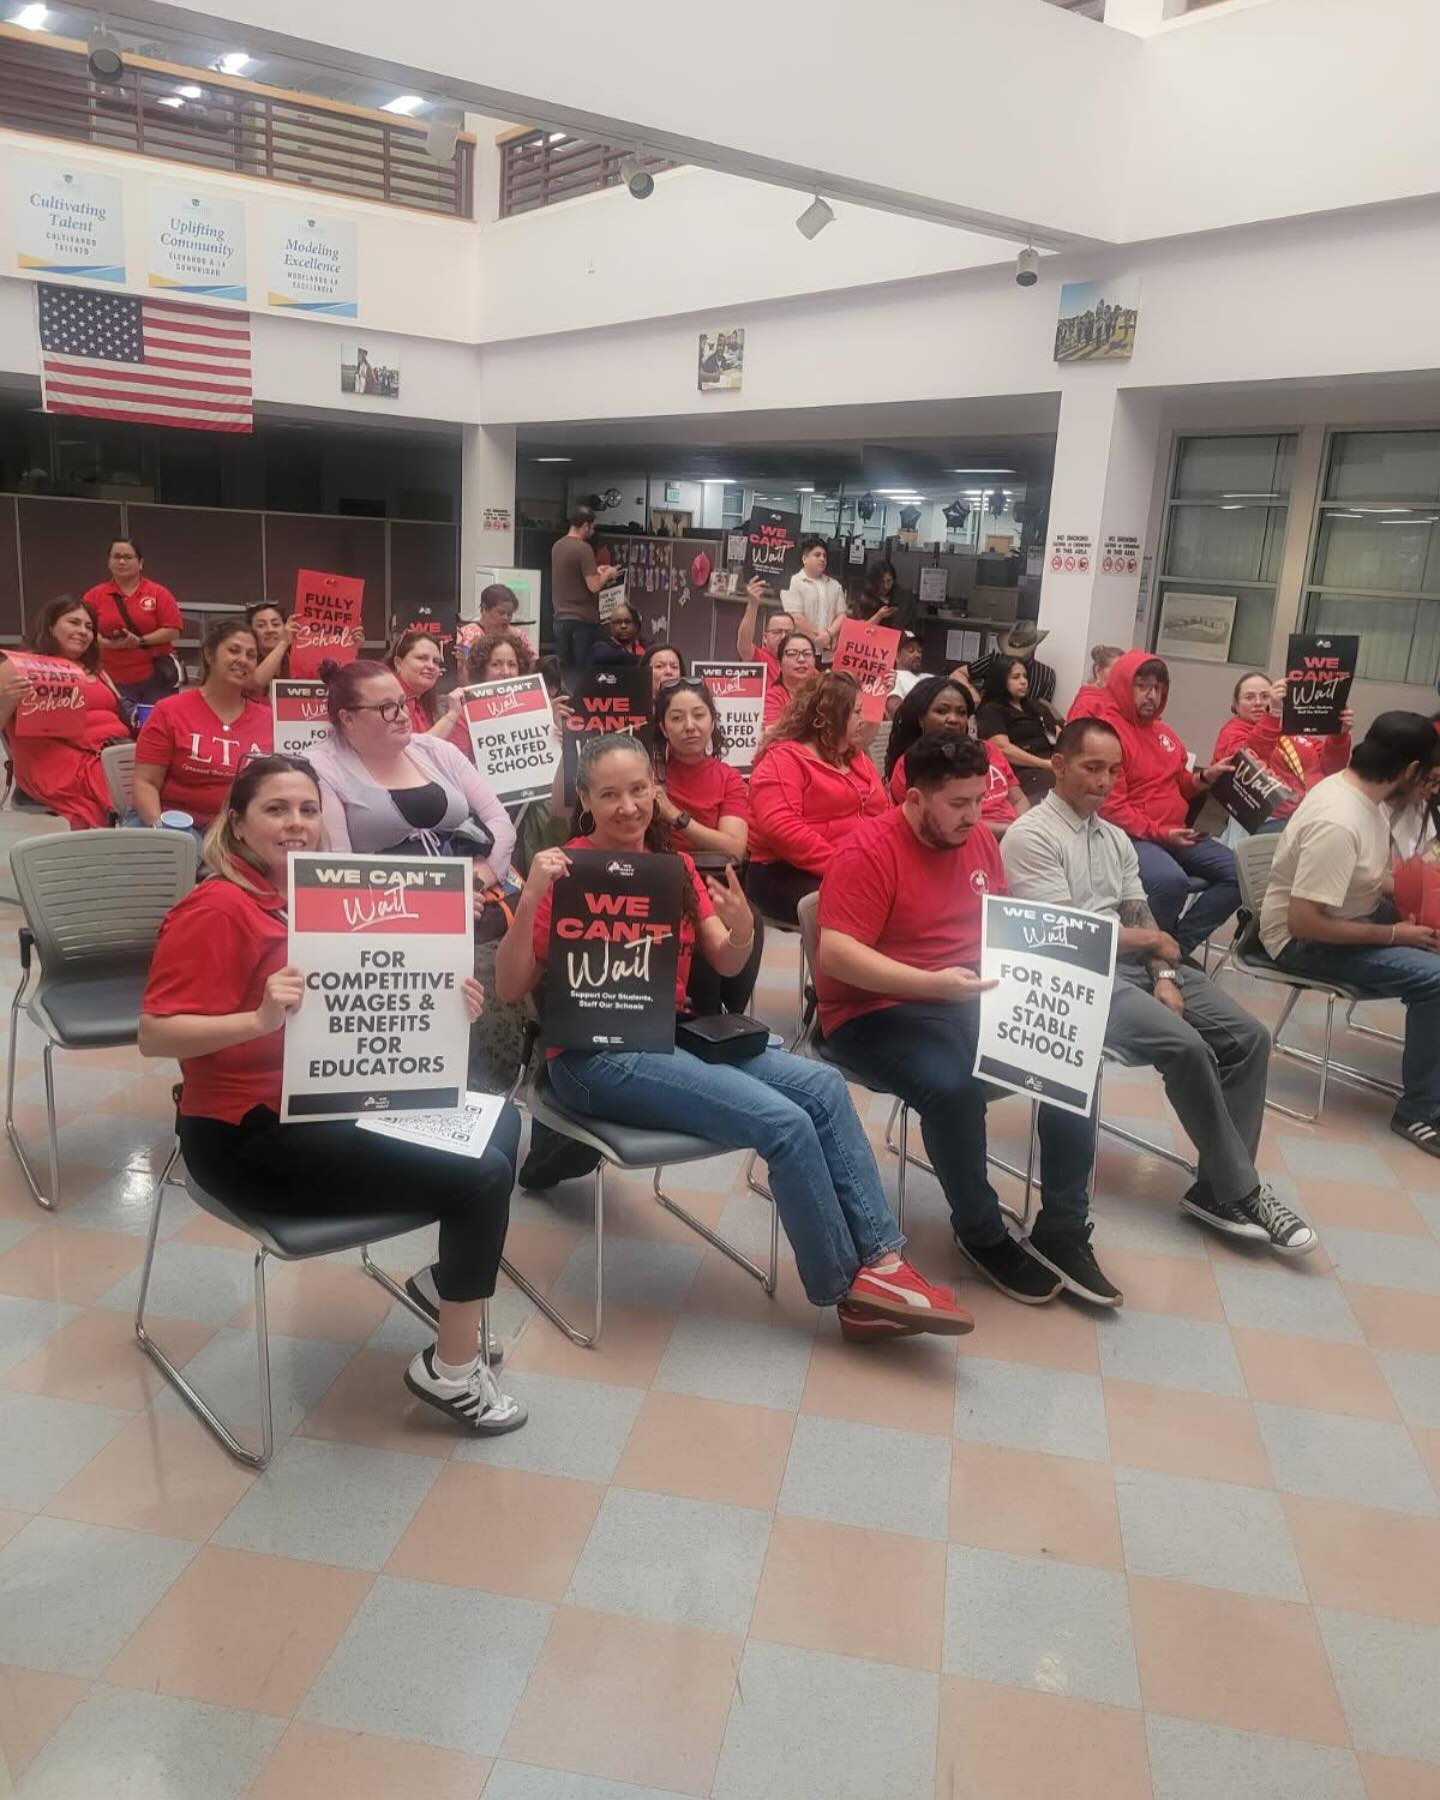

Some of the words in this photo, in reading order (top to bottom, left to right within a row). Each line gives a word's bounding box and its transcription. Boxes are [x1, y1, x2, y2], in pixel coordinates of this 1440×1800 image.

[30, 193, 106, 221] Cultivating
[50, 213, 92, 232] Talent
[170, 218, 225, 242] Uplifting
[160, 232, 234, 258] Community
[286, 239, 339, 260] Modeling
[284, 254, 341, 272] Excellence
[761, 525, 786, 537] WE
[752, 543, 795, 564] Wait
[306, 593, 353, 610] FULLY
[304, 607, 352, 623] STAFF
[310, 622, 344, 635] OUR
[408, 623, 441, 632] WE
[296, 626, 354, 648] Schools
[846, 642, 889, 660] FULLY
[842, 655, 886, 673] STAFF
[1304, 657, 1339, 668] WE
[27, 669, 78, 683] STAFF
[726, 669, 756, 677] CAN'T
[1289, 670, 1350, 682] CAN'T
[36, 685, 74, 698] OUR
[287, 688, 311, 696] WE
[473, 688, 494, 698] WE
[497, 682, 532, 694] CAN'T
[713, 674, 742, 695] Wait
[1293, 677, 1343, 705] Wait
[22, 686, 85, 715] Schools
[487, 691, 520, 716] Wait
[583, 697, 629, 712] WE
[566, 716, 647, 731] CAN'T
[727, 712, 760, 723] FULLY
[311, 730, 327, 740] FO
[477, 734, 508, 749] FOR
[510, 725, 551, 742] FULLY
[720, 726, 754, 735] AFFED
[489, 740, 547, 761] STAFFED
[725, 737, 756, 748] OOLS
[487, 752, 554, 776] SCHOOLS
[1235, 760, 1292, 799] Wait
[315, 869, 361, 884] WE
[369, 869, 446, 886] CAN'T
[342, 886, 412, 929] Wait
[584, 893, 650, 917] WE
[1003, 907, 1037, 920] WE
[1042, 912, 1100, 935] CAN'T
[556, 918, 673, 945] CAN'T
[1024, 921, 1071, 948] Wait
[361, 950, 405, 968] FOR
[567, 934, 673, 989] Wait
[306, 972, 455, 990] COMPETITIVE
[1000, 963, 1042, 988] FOR
[1050, 976, 1095, 1006] SAFE
[325, 994, 410, 1012] WAGES
[419, 994, 436, 1011] &
[570, 990, 600, 1000] Support
[602, 992, 616, 1000] Our
[1026, 990, 1070, 1016] AND
[579, 1000, 598, 1008] Staff
[599, 1001, 613, 1009] Our
[615, 1002, 644, 1010] Schools
[329, 1015, 431, 1034] BENEFITS
[1012, 1006, 1078, 1042] STABLE
[357, 1037, 402, 1054] FOR
[997, 1021, 1085, 1067] SCHOOLS
[309, 1056, 444, 1078] EDUCATORS
